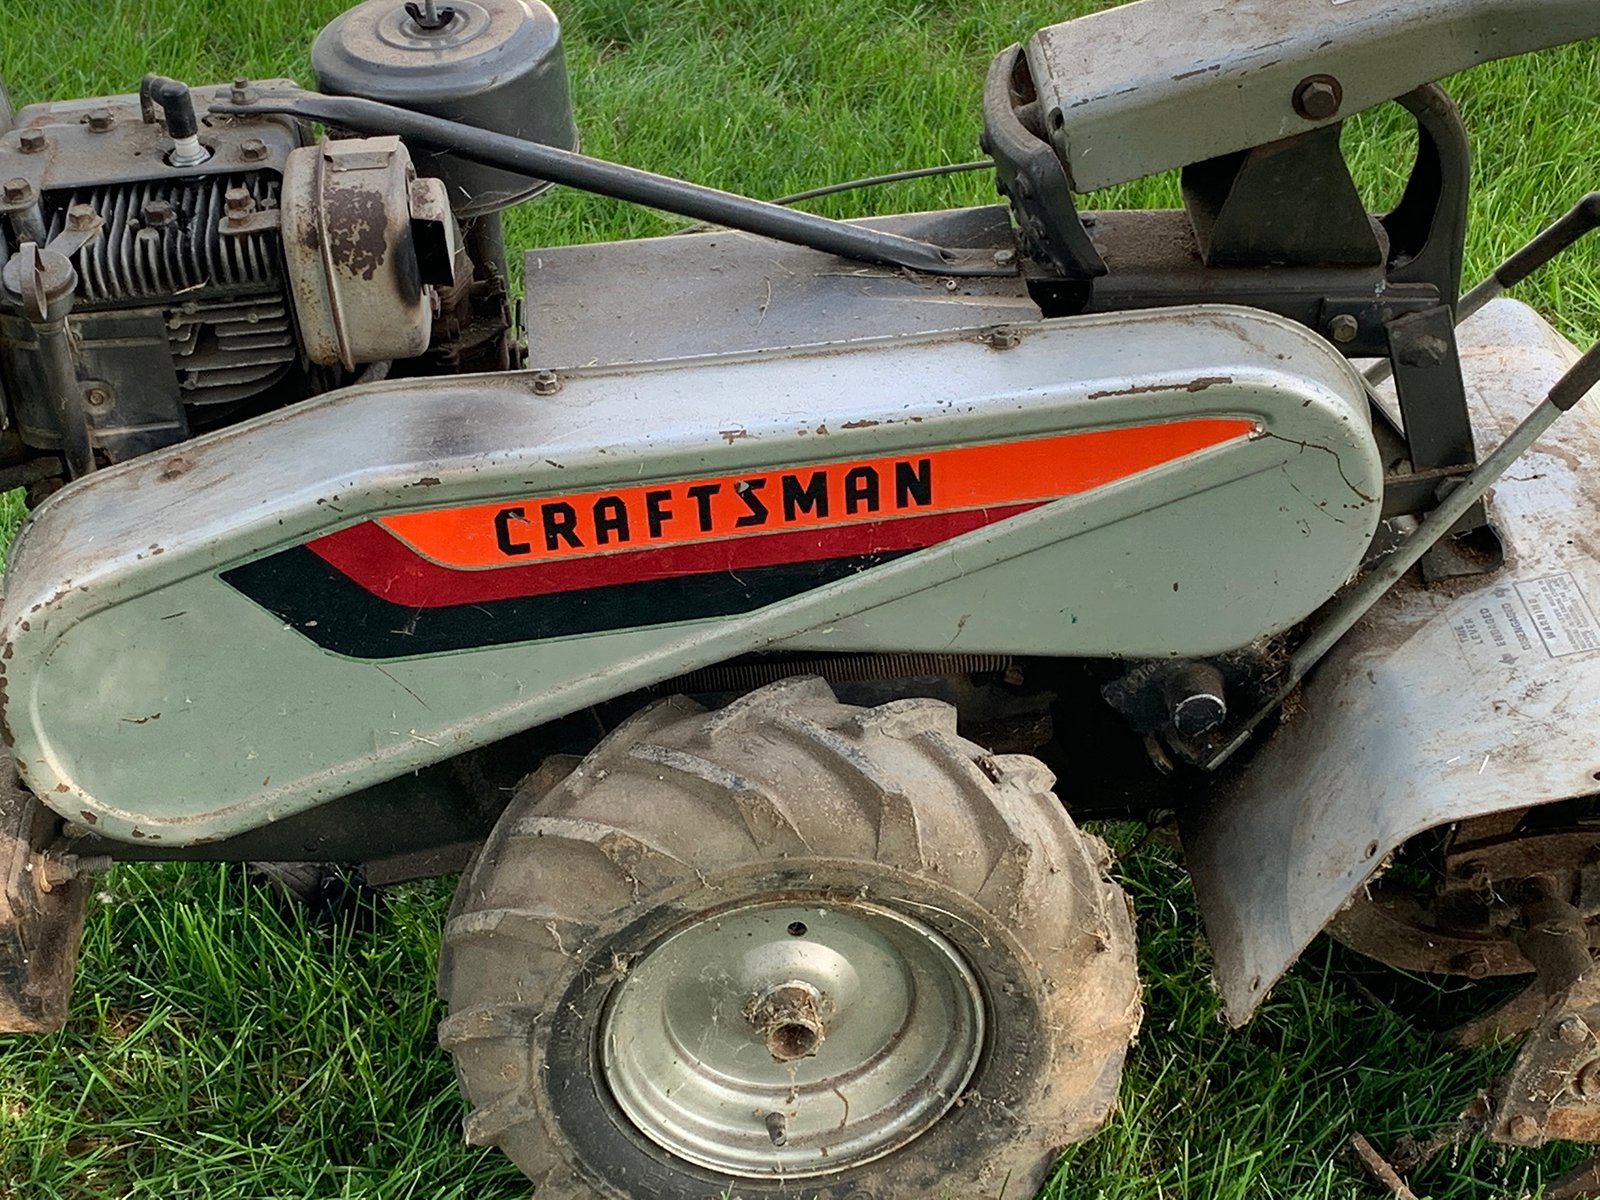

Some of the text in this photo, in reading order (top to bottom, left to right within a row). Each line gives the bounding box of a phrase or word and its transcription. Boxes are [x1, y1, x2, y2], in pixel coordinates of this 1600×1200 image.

[494, 458, 932, 556] CRAFTSMAN
[1463, 618, 1484, 645] LEVER
[1480, 608, 1506, 647] ENGAGED
[1502, 603, 1532, 651] DISENGAGED
[1528, 598, 1557, 640] WARNING
